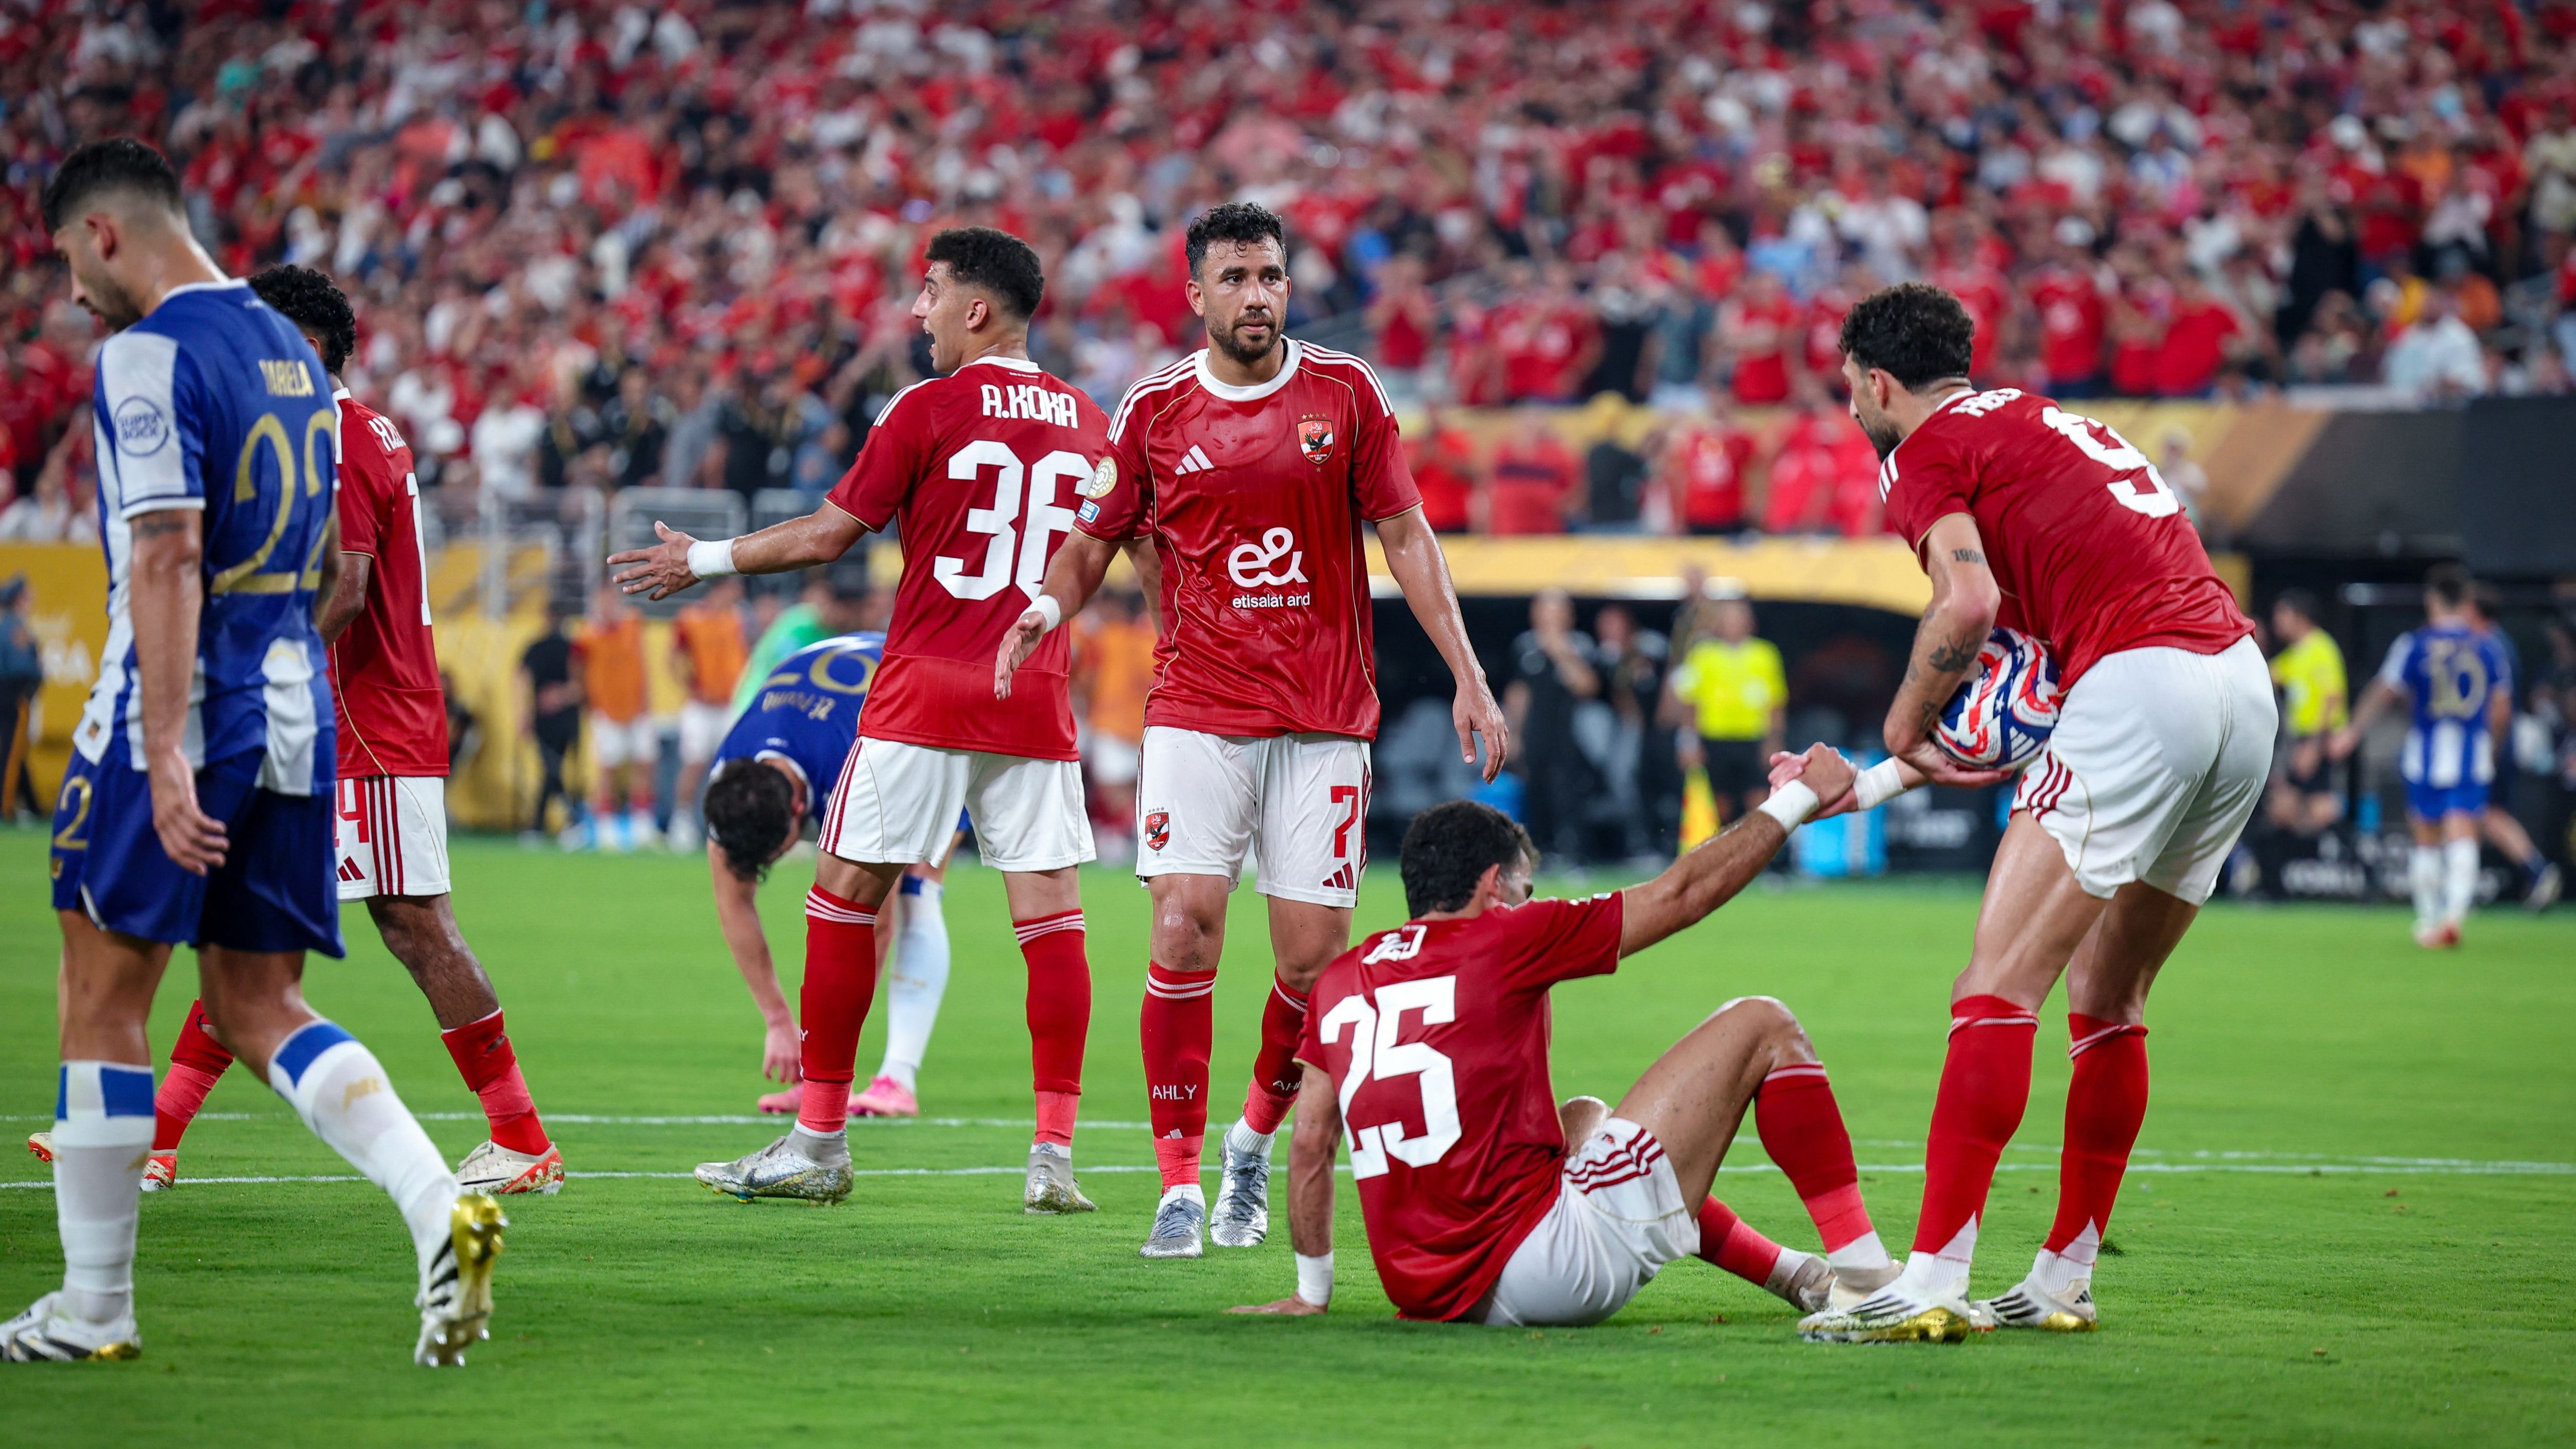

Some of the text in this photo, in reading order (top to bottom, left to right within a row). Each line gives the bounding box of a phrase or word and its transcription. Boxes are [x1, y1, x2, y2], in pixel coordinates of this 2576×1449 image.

[980, 384, 1079, 429] A.KOKA
[2042, 406, 2179, 518] 9
[933, 440, 1095, 601] 36
[1228, 527, 1309, 588] e&
[1232, 594, 1284, 608] etisalat
[1330, 785, 1358, 858] 7
[1152, 1084, 1197, 1100] AHLY
[1320, 975, 1462, 1181] 25
